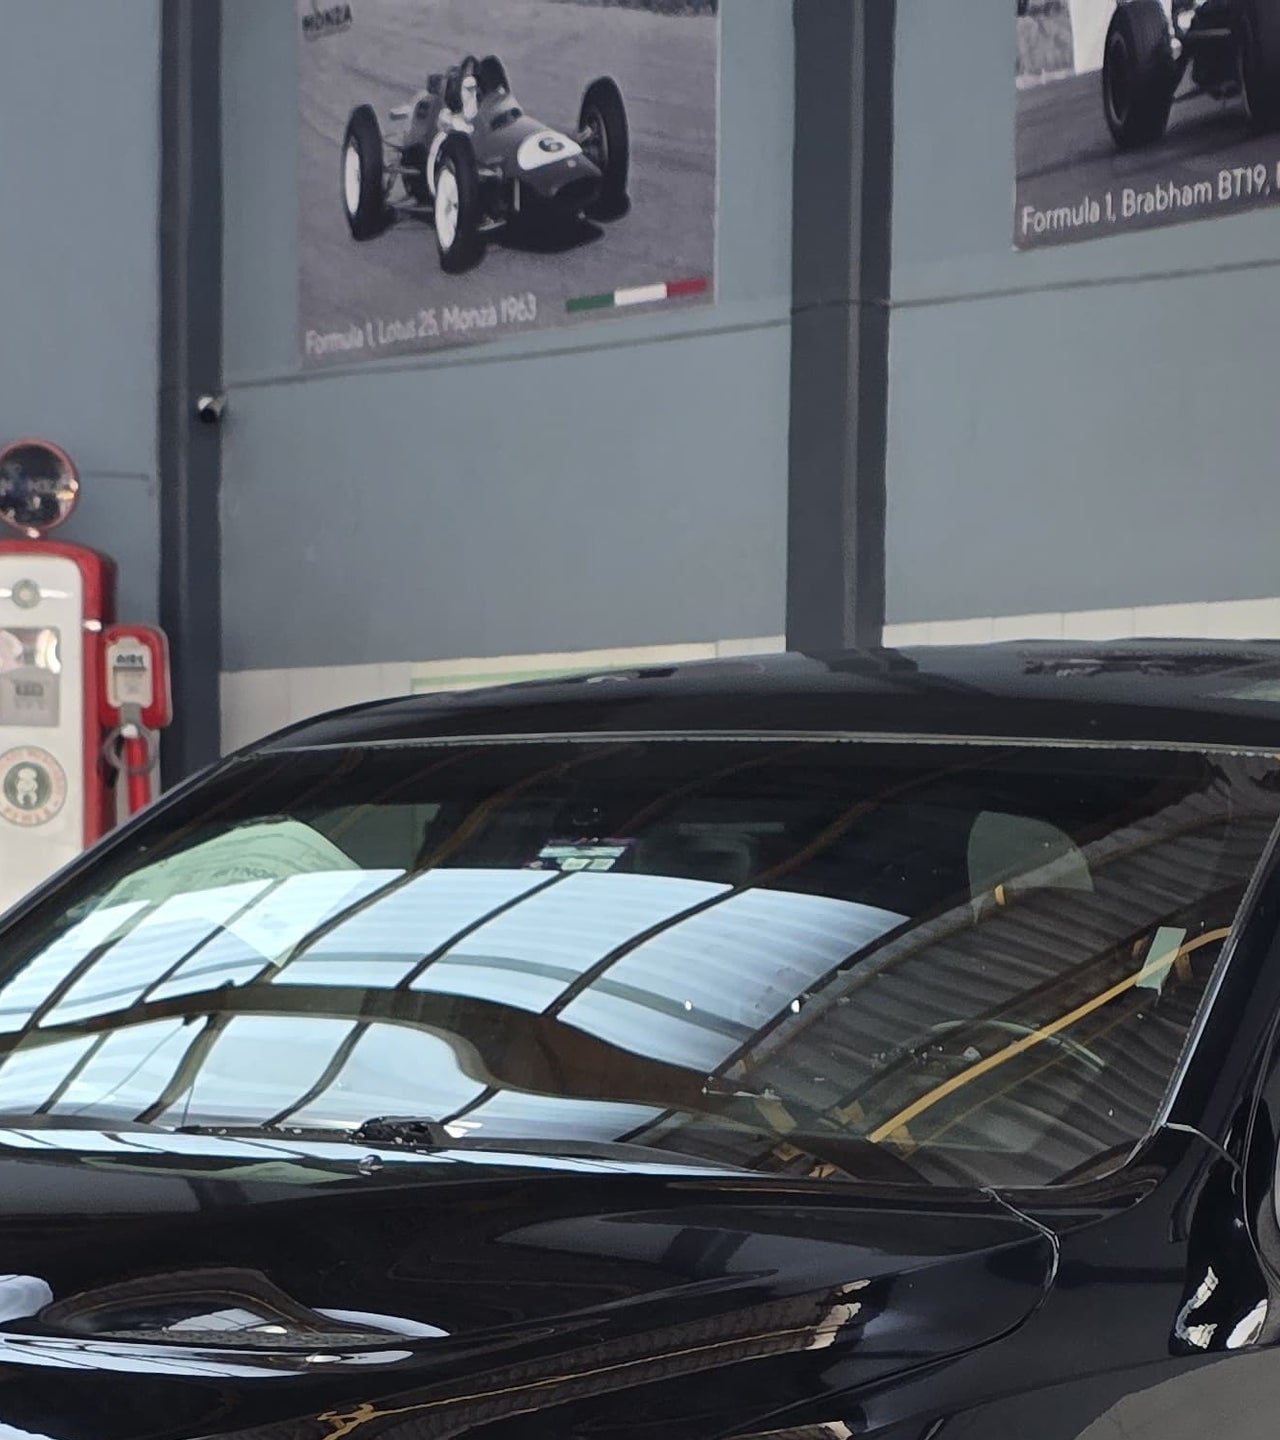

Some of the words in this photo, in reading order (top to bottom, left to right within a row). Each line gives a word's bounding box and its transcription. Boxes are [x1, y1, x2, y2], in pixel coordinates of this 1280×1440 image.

[1022, 196, 1100, 235] Formula
[1105, 191, 1117, 224] 1,
[1122, 181, 1212, 218] Brabham
[1218, 163, 1270, 201] BT19,
[305, 323, 364, 354] Formula
[442, 303, 498, 332] Monza
[500, 291, 537, 324] 1963
